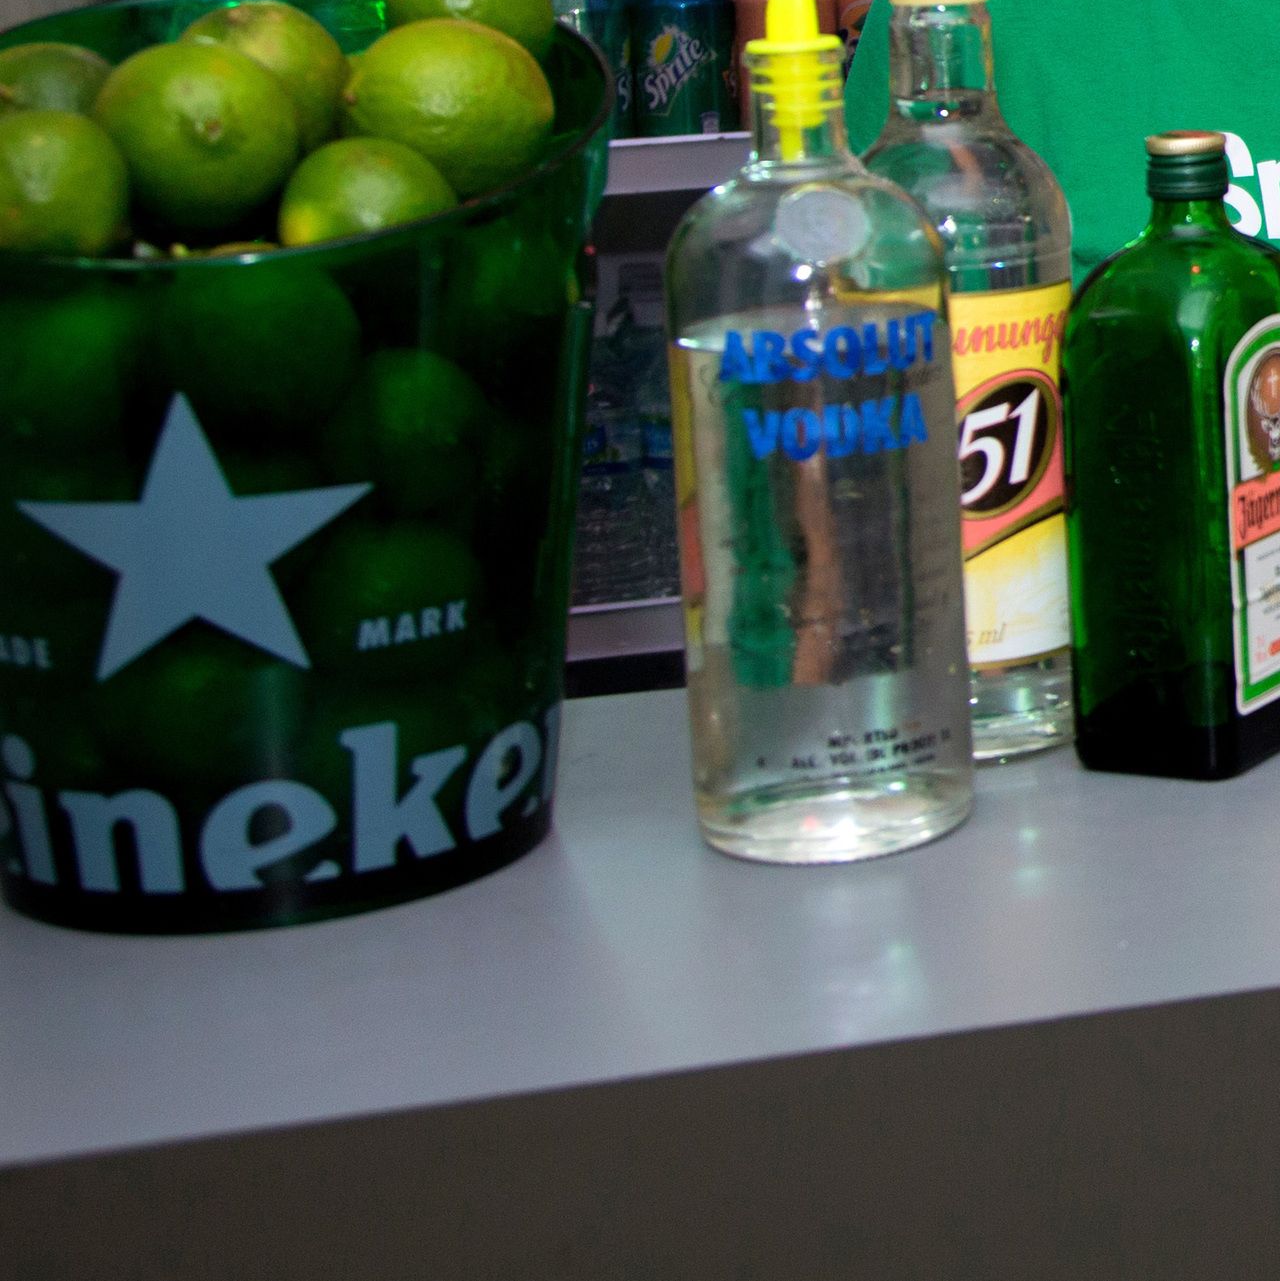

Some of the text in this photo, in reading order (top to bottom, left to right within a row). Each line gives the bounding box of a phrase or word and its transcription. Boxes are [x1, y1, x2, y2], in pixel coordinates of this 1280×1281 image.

[643, 33, 704, 111] Sprite
[719, 311, 938, 384] ABSOLUT
[743, 392, 929, 461] VODKA
[958, 387, 1040, 506] 51
[357, 600, 467, 651] MARK
